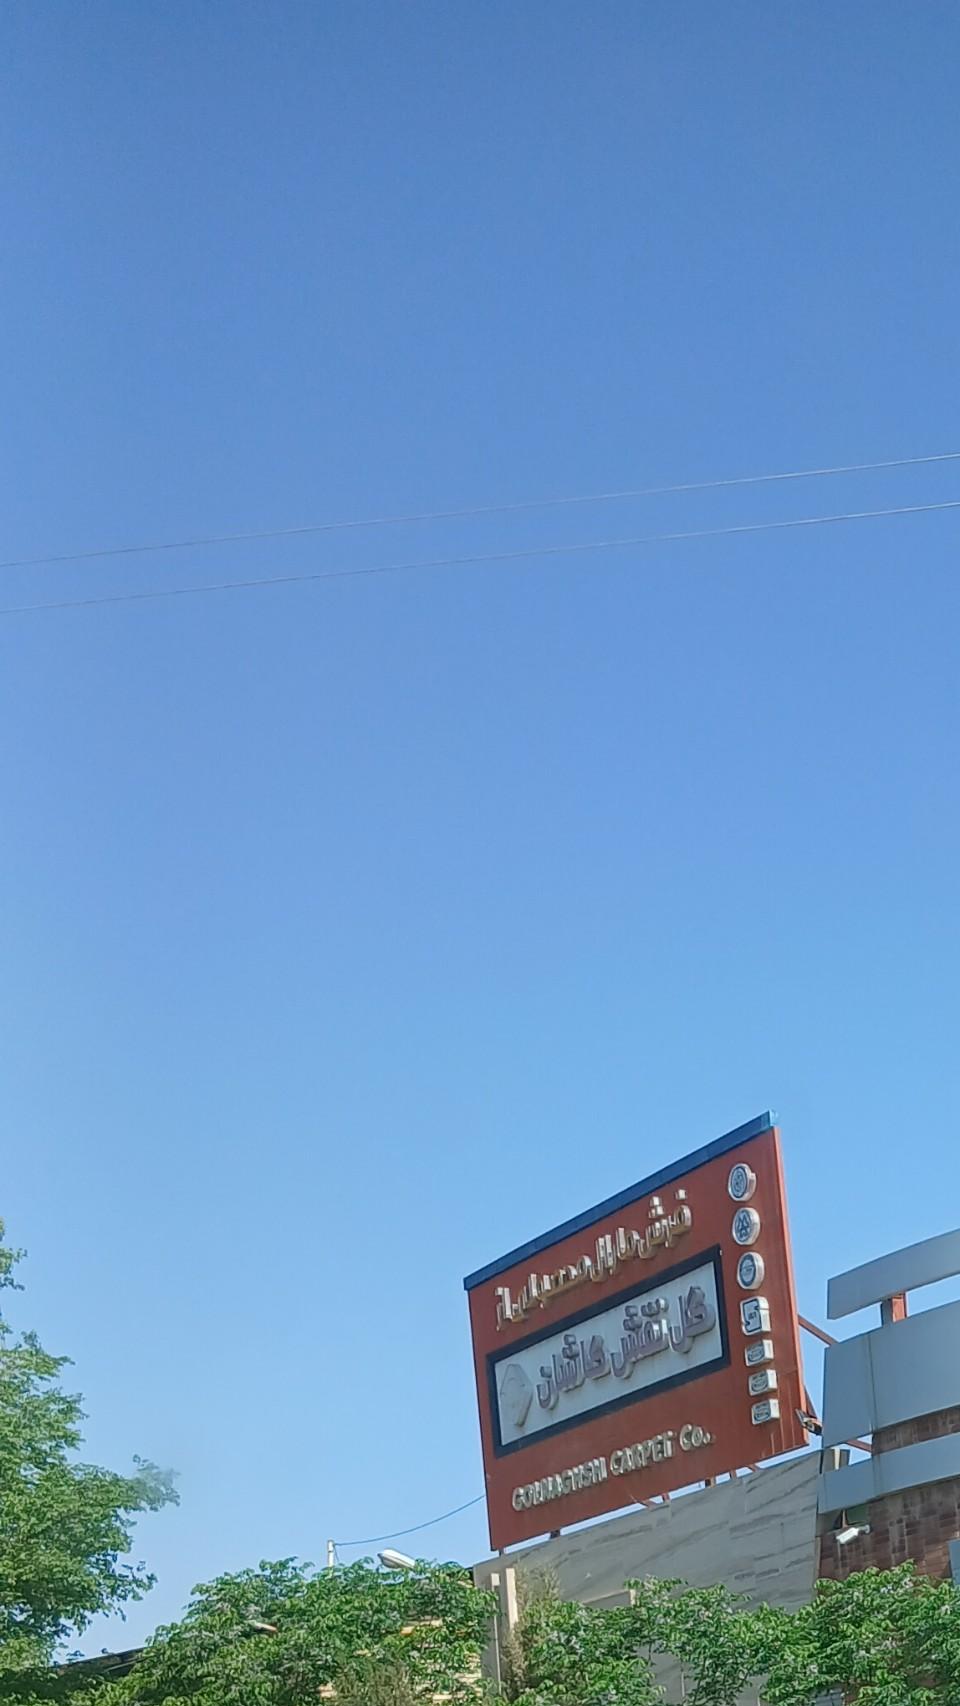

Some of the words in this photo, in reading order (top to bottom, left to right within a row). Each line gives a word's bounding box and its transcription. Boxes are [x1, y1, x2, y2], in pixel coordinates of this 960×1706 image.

[639, 1189, 692, 1259] فرش
[610, 1298, 669, 1379] نقش
[669, 1285, 716, 1353] گل
[536, 1333, 611, 1411] کاشان
[610, 1430, 676, 1476] CARPET
